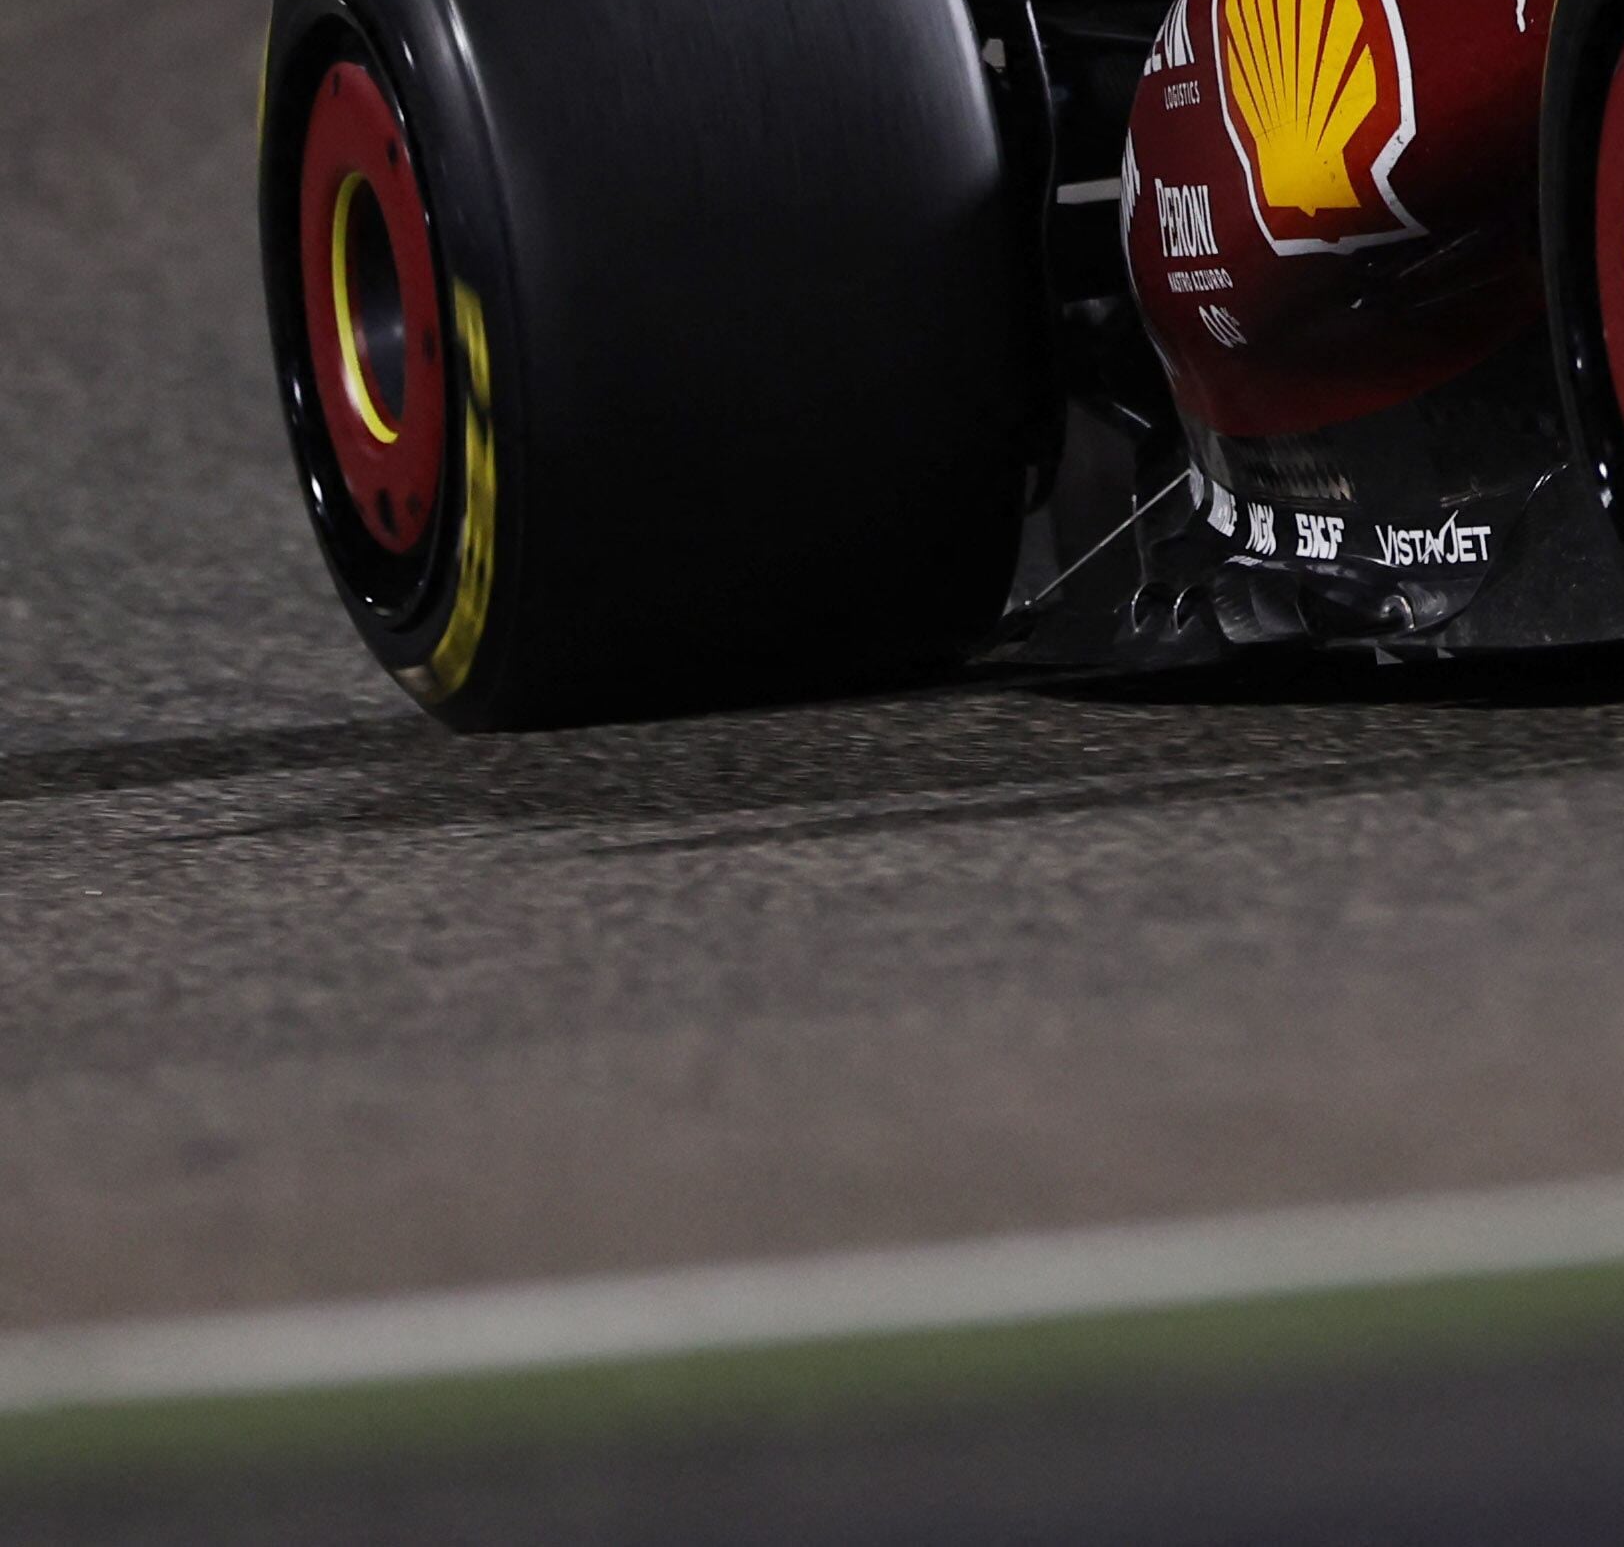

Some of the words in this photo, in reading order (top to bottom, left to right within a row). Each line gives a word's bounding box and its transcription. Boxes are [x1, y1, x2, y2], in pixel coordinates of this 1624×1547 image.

[1163, 79, 1201, 111] LOGISTICS
[1154, 177, 1219, 258] PERONI
[1245, 502, 1277, 556] NGK
[1295, 512, 1345, 560] SKF
